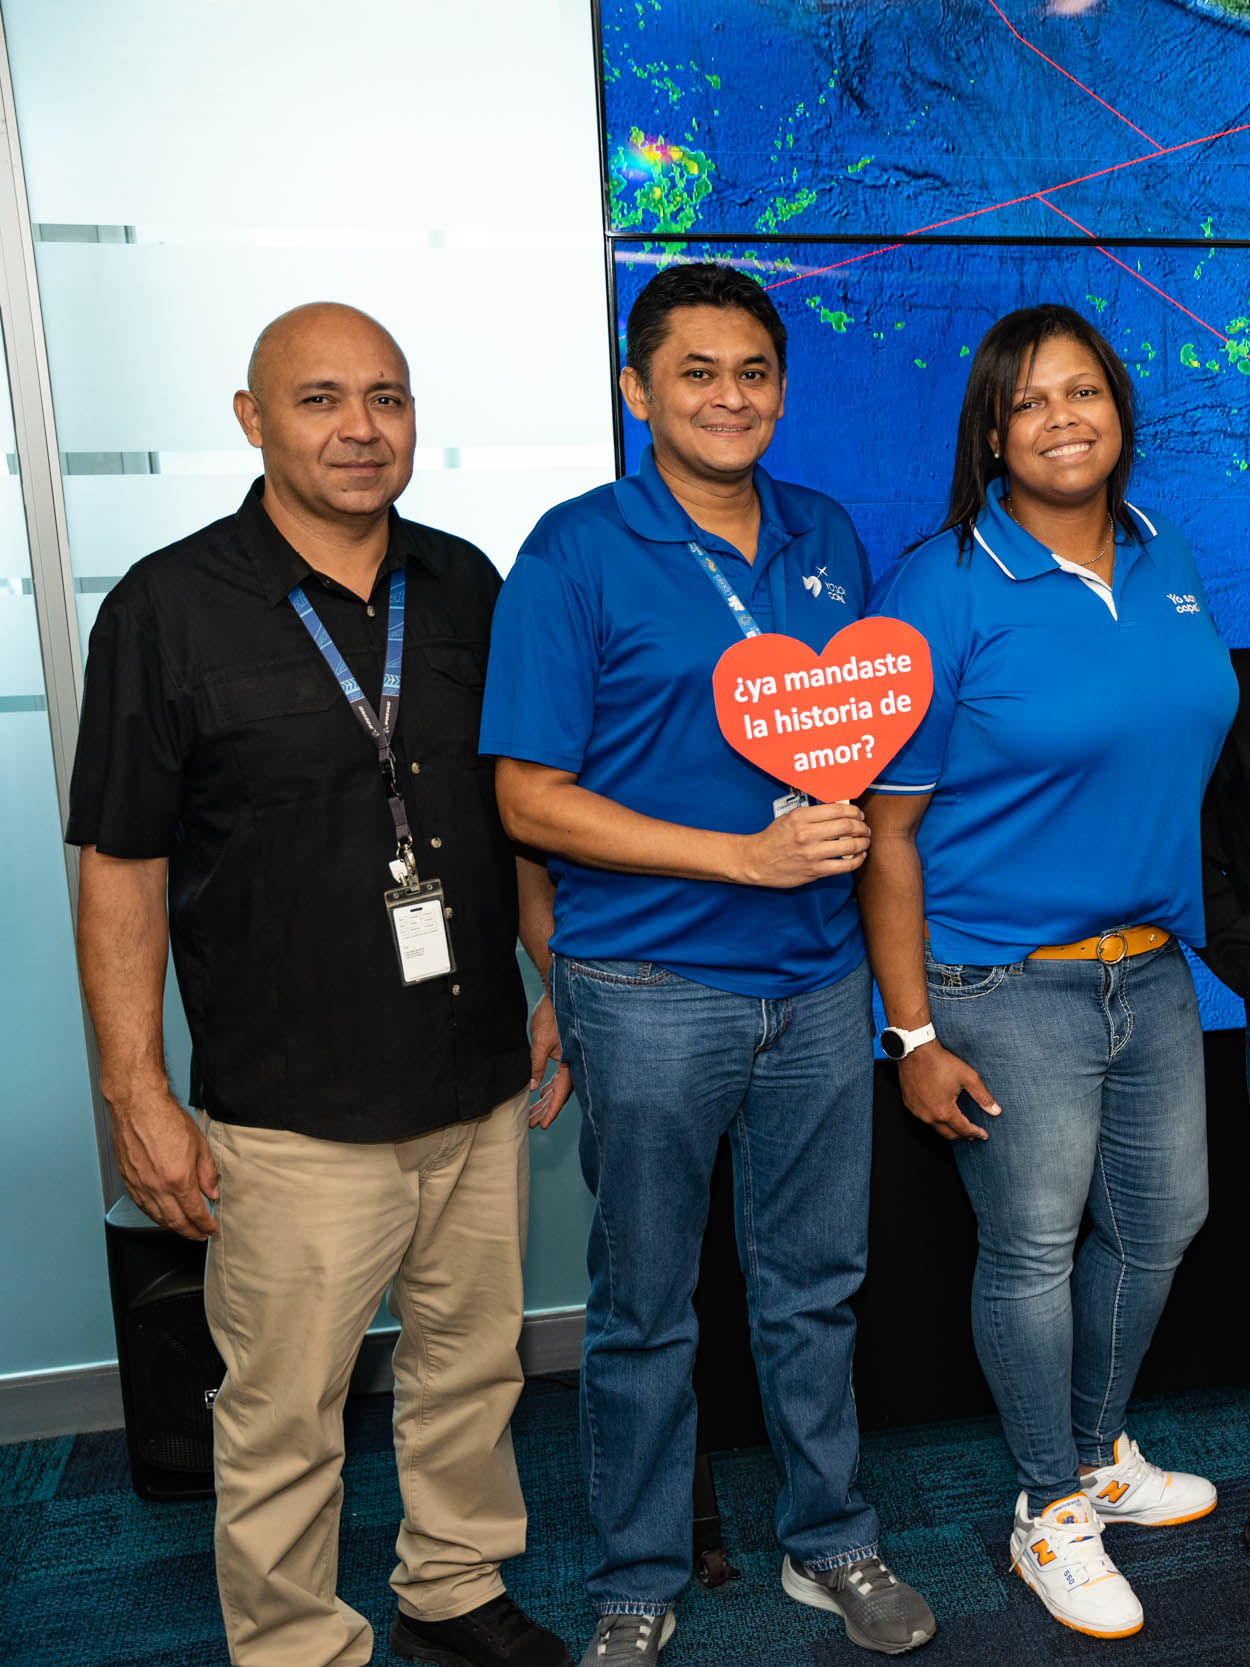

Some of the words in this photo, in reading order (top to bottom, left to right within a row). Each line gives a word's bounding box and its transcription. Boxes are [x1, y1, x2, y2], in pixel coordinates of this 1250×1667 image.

[734, 676, 777, 703] ¿ya
[784, 653, 912, 692] mandaste
[744, 714, 768, 739] la
[774, 697, 873, 734] historia
[879, 690, 912, 715] de
[793, 734, 875, 771] amor?
[1063, 1570, 1075, 1585] 550
